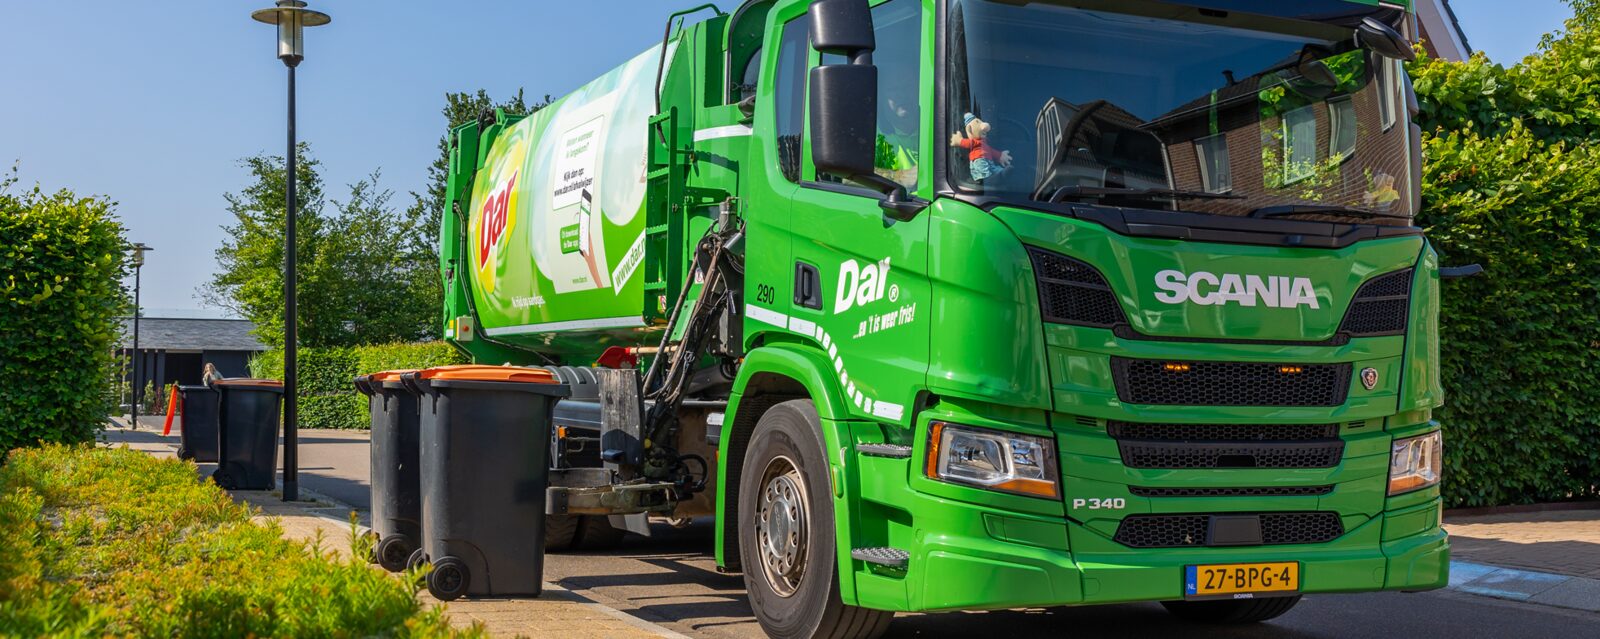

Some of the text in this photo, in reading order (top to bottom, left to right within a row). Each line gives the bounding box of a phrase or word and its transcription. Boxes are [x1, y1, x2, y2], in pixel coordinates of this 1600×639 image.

[480, 169, 518, 269] Dar
[615, 238, 645, 288] www.dar.n
[757, 283, 775, 305] 290
[834, 256, 891, 315] Dar
[1153, 269, 1320, 310] SCANIA
[873, 314, 880, 333] is
[880, 309, 898, 330] weer
[898, 303, 916, 325] fris!
[1073, 498, 1126, 510] P 340
[1204, 566, 1291, 590] 27-BPG-4
